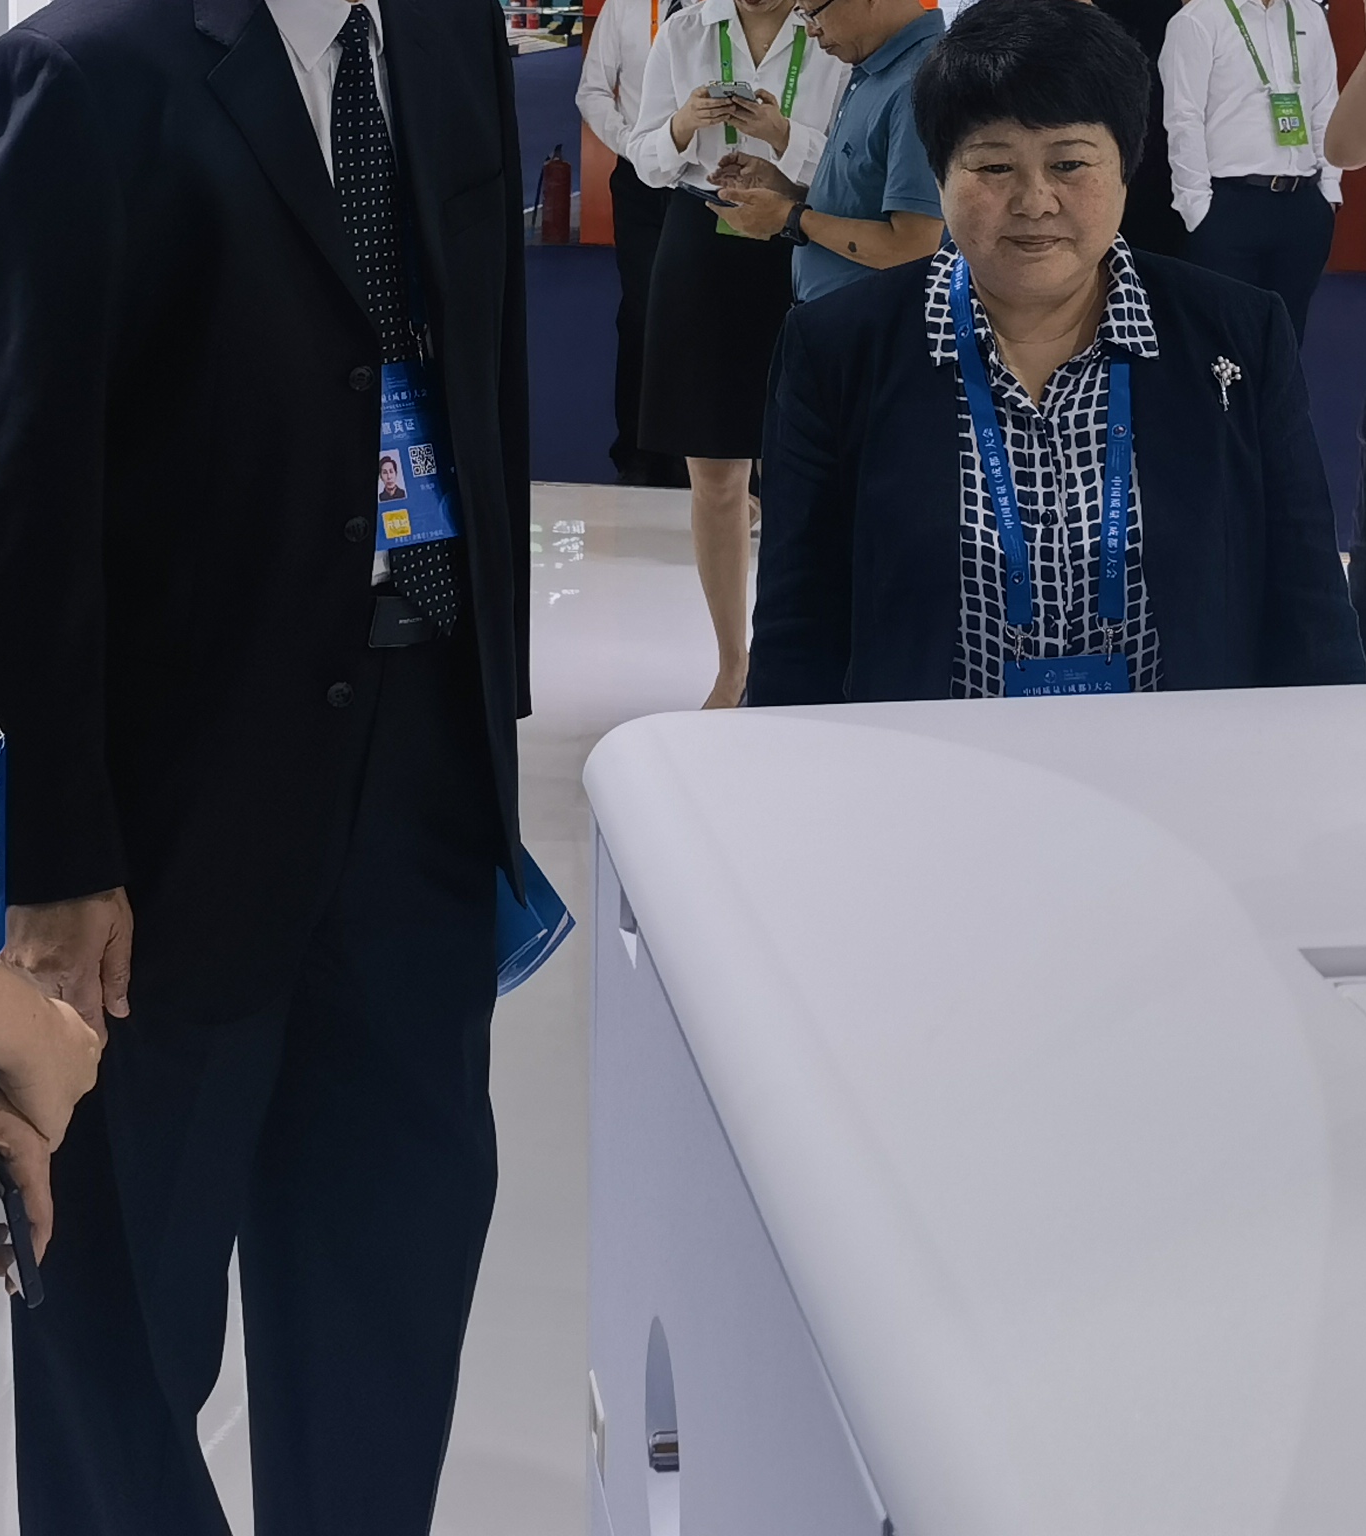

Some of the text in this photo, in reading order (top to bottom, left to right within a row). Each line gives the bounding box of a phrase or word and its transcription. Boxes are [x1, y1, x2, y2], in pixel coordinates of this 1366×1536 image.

[1106, 475, 1123, 579] 中国质量（成都）大会
